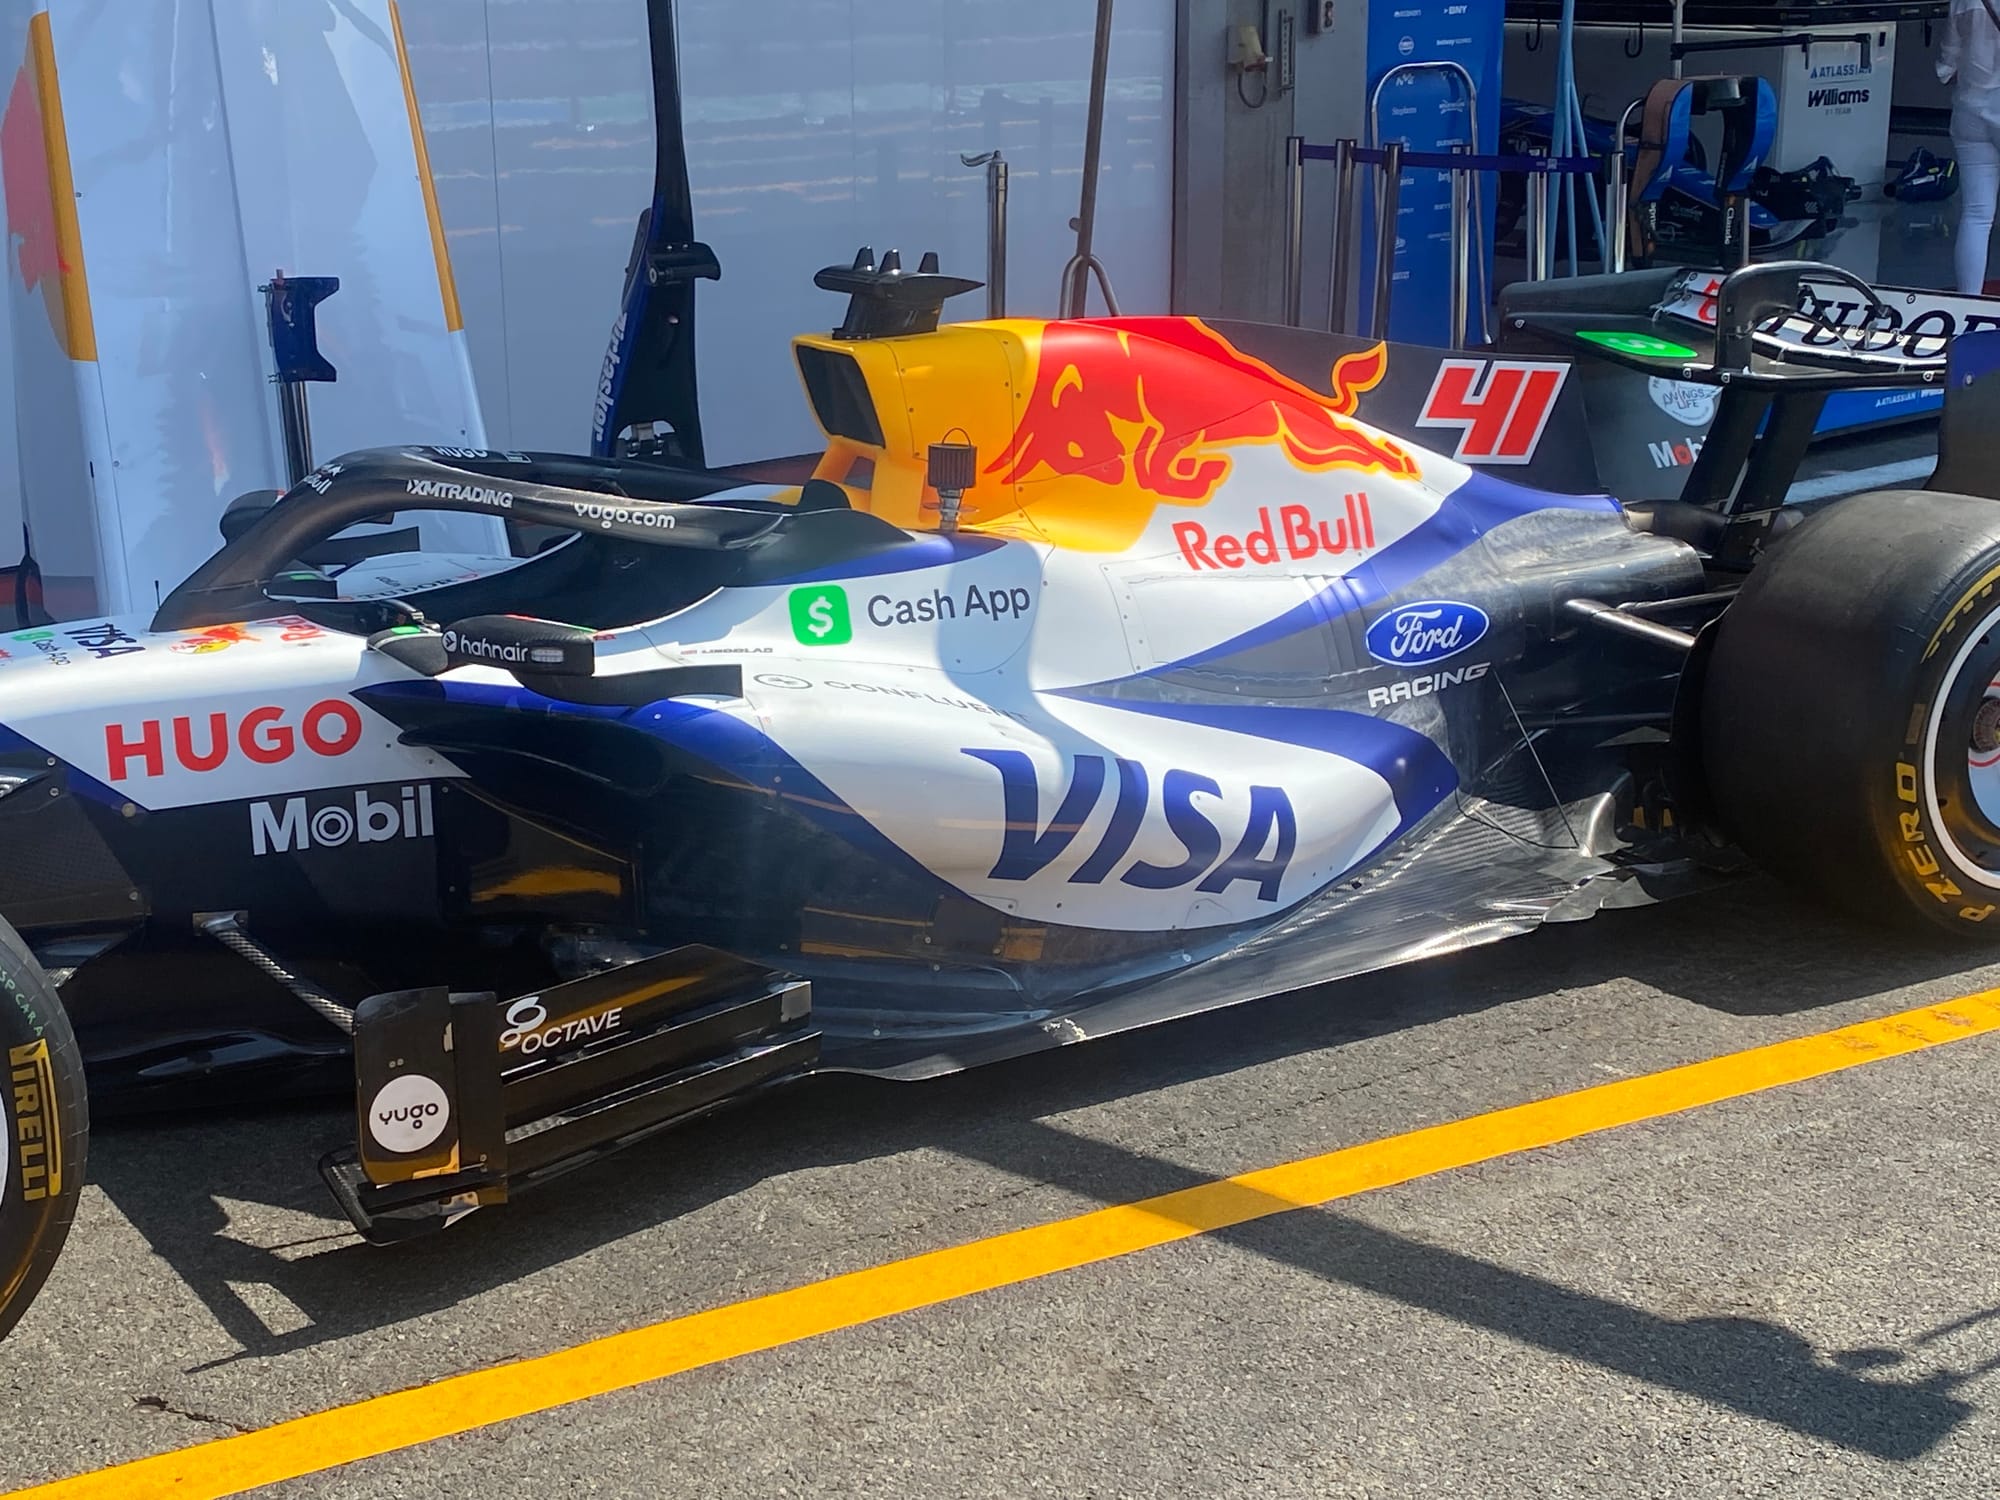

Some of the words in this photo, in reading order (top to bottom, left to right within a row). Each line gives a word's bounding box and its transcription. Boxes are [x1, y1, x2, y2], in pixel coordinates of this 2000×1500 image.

[1808, 88, 1869, 107] Williams
[1416, 359, 1571, 464] 41
[409, 480, 514, 509] XMTRADING
[574, 502, 676, 529] yugo.com
[1172, 507, 1281, 571] Red
[1280, 493, 1376, 560] Bull
[868, 588, 956, 627] Cash
[964, 584, 1031, 621] App
[64, 623, 146, 659] VISA
[460, 634, 529, 663] hahnair
[1390, 609, 1463, 658] Ford
[823, 680, 1031, 722] CONFLUENT
[1367, 662, 1491, 709] RACING
[105, 699, 362, 781] HUGO
[250, 784, 435, 857] Mobil
[960, 748, 1297, 902] VISA
[1896, 762, 1963, 904] ZERO
[521, 1007, 622, 1055] OCTAVE
[9, 1038, 62, 1201] PIRELLI
[379, 1102, 439, 1130] yugo
